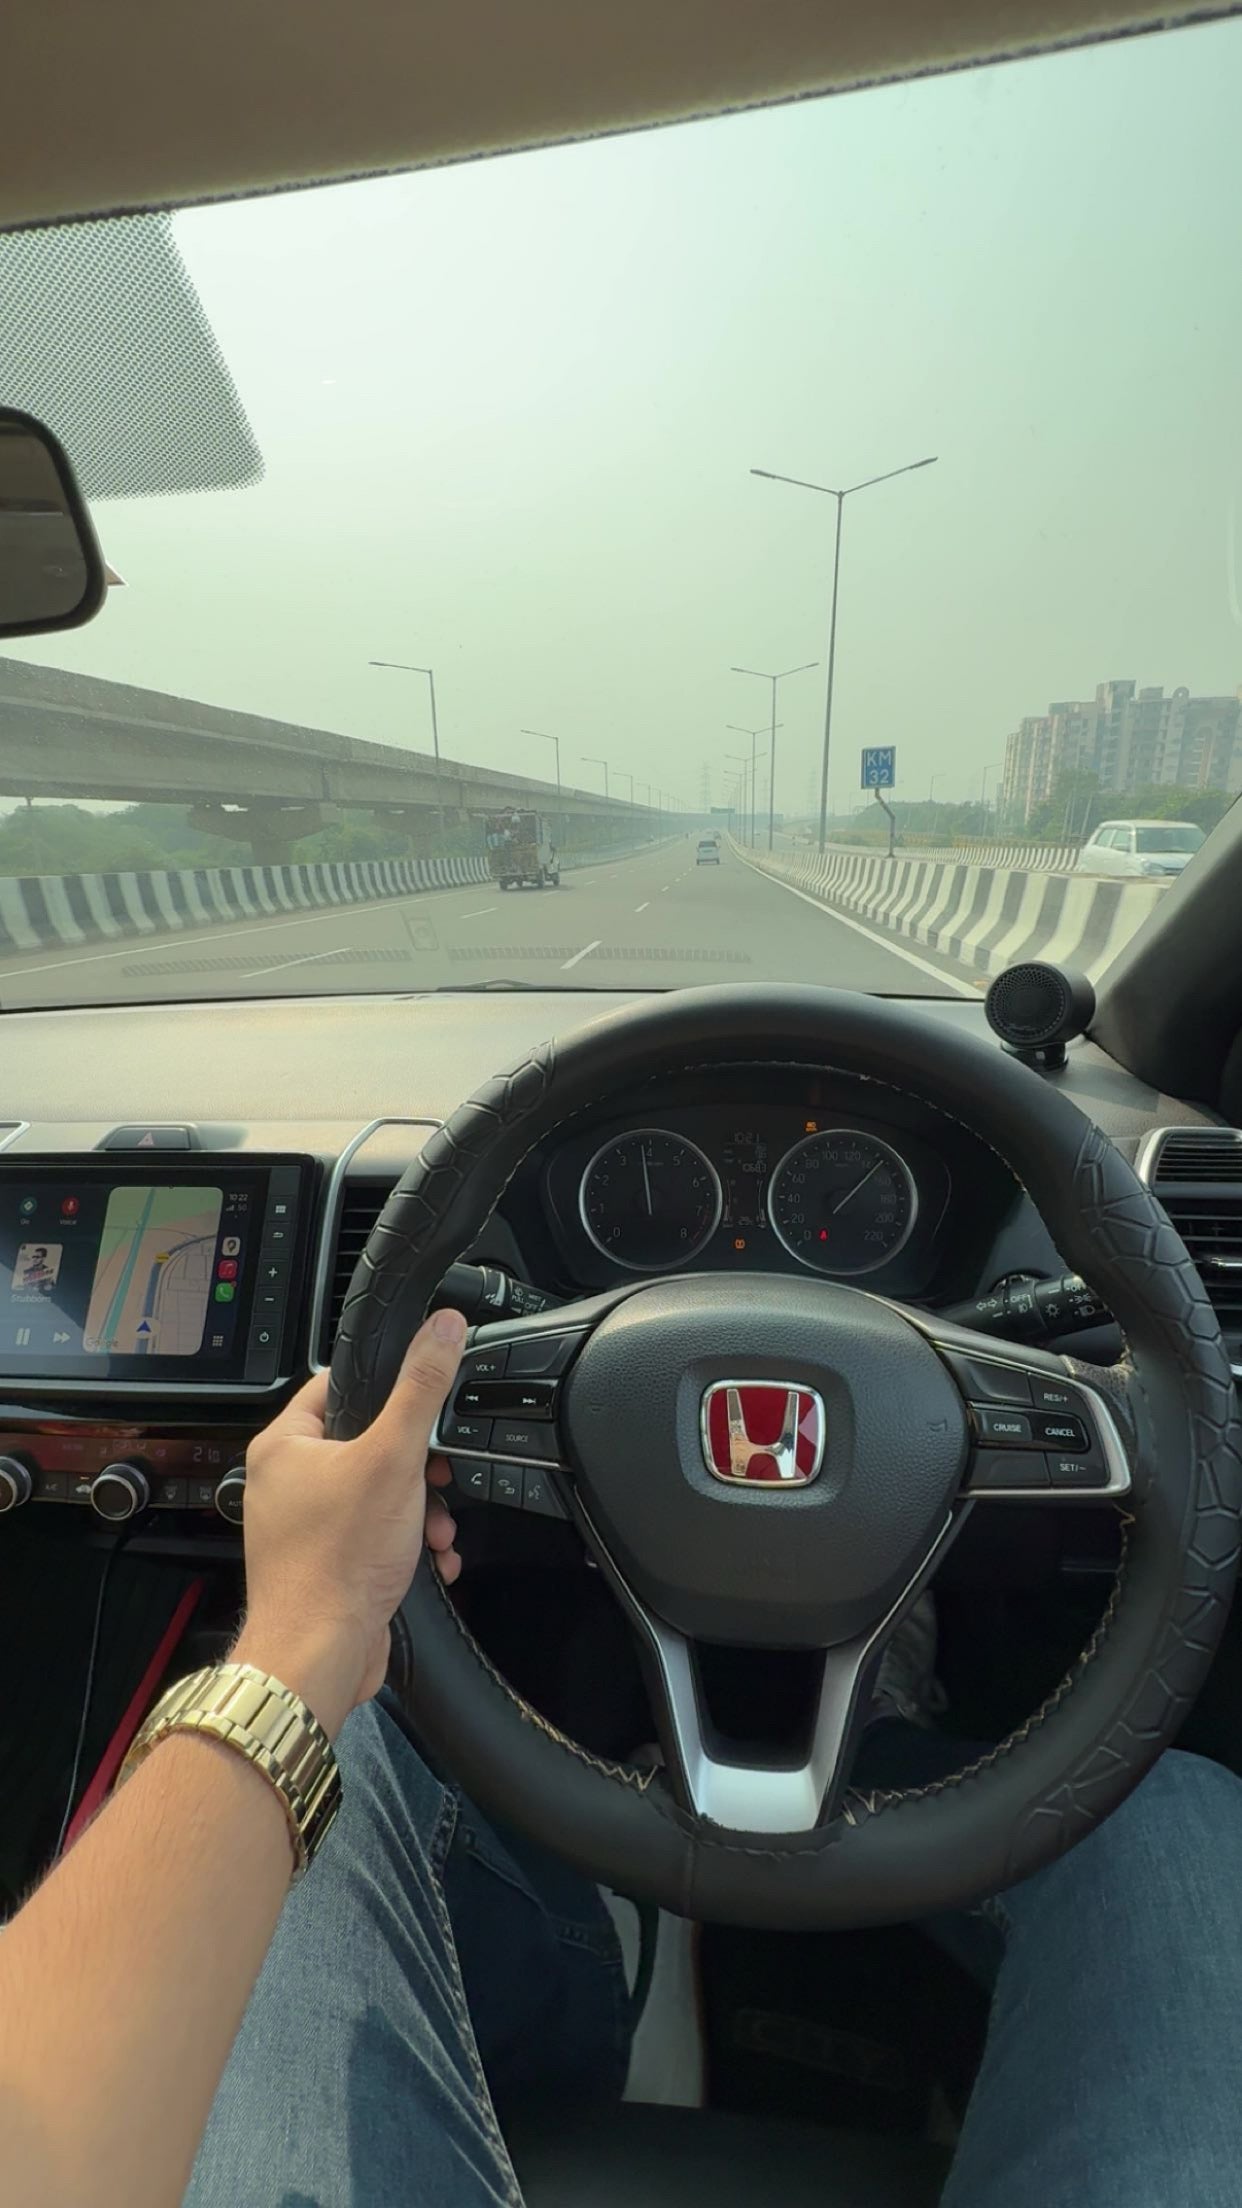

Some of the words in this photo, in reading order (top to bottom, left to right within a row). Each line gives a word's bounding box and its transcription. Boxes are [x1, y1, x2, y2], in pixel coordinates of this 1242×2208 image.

[867, 750, 892, 767] KM
[869, 769, 890, 784] 32
[646, 1147, 653, 1157] 4
[822, 1151, 839, 1161] 100
[844, 1151, 862, 1161] 120
[620, 1155, 627, 1166] 3
[673, 1156, 681, 1166] 5
[805, 1159, 820, 1169] 80
[602, 1175, 609, 1186] 2
[692, 1178, 700, 1188] 6
[792, 1173, 806, 1184] 60
[787, 1193, 801, 1204] 40
[599, 1203, 605, 1213] 1
[696, 1206, 703, 1217] 7
[791, 1214, 805, 1224] 20
[613, 1227, 621, 1238] 0
[680, 1228, 688, 1238] 8
[803, 1230, 812, 1241] 0
[864, 1231, 884, 1241] 220
[512, 1295, 525, 1304] PULL
[1010, 1294, 1027, 1303] OFF
[993, 1423, 1022, 1434] CRUISE
[1044, 1426, 1075, 1438] CANCEL
[505, 1434, 529, 1443] SOURCE
